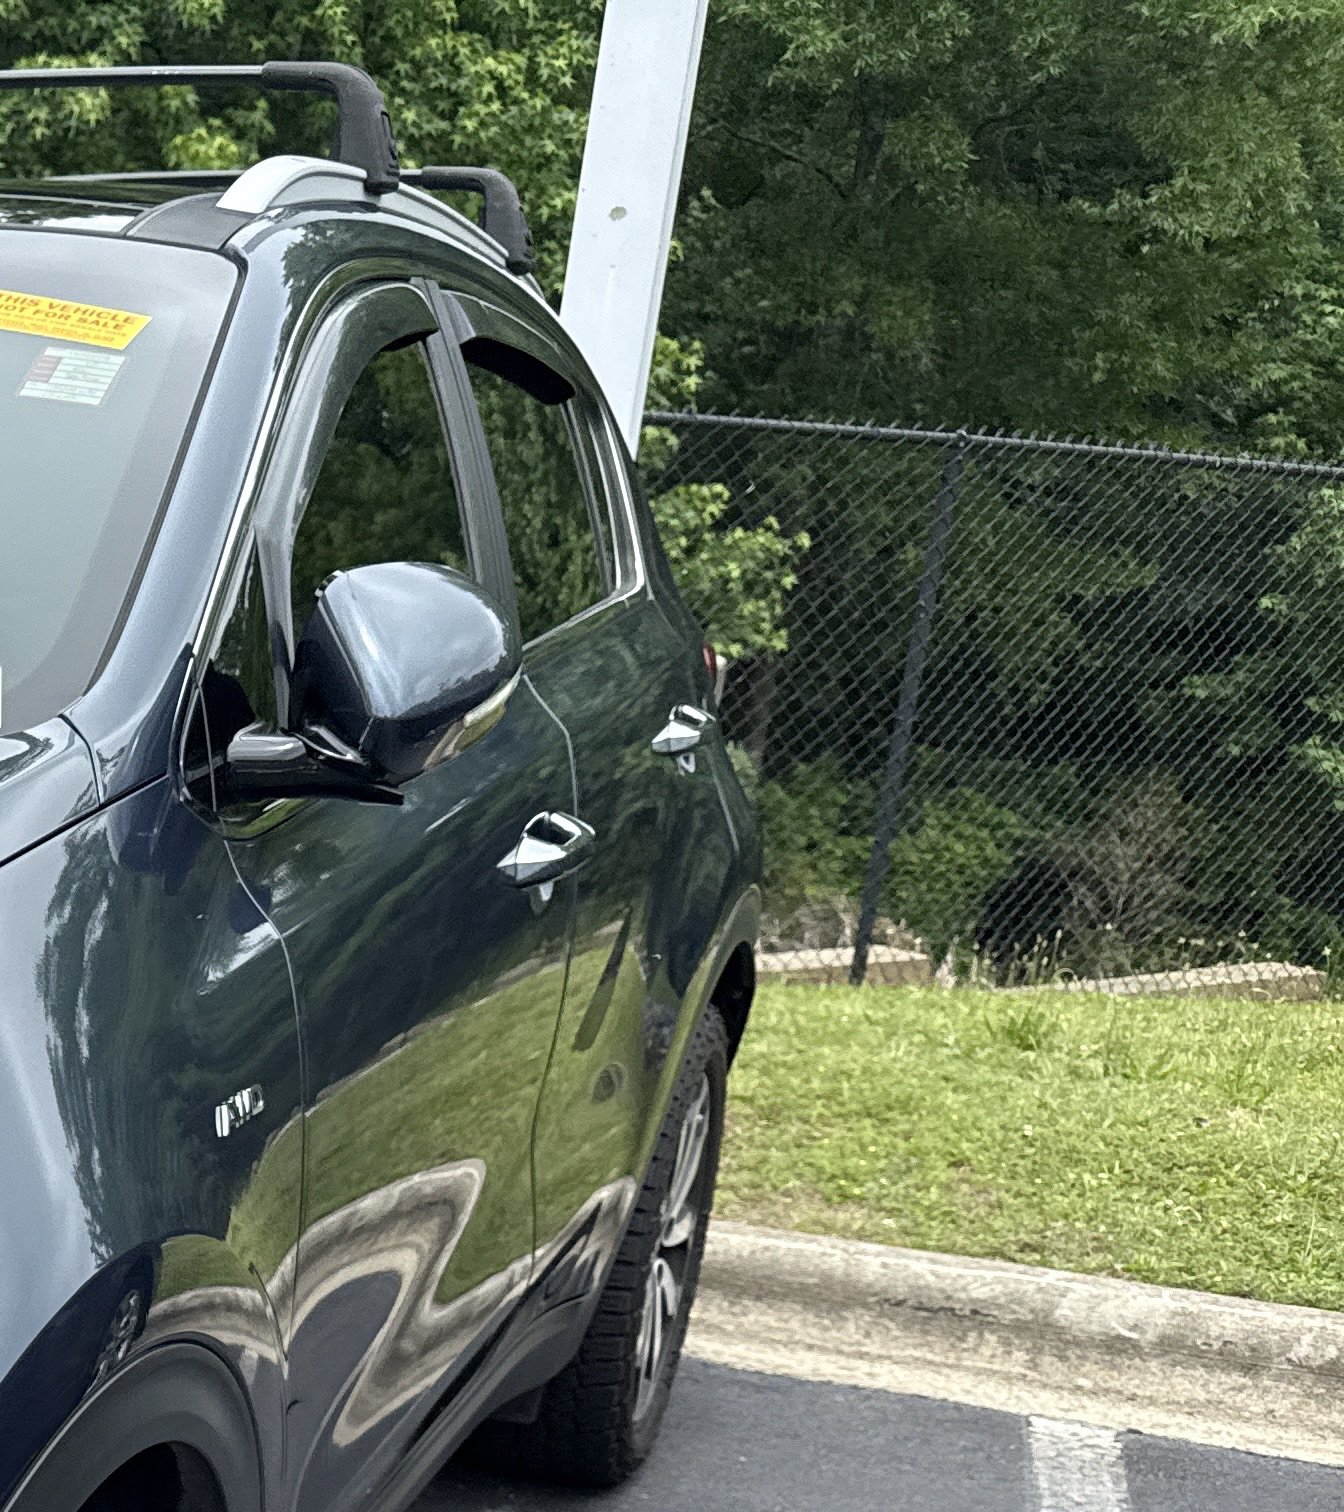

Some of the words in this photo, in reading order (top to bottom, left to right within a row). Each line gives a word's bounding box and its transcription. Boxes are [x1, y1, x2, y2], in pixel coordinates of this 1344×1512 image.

[33, 308, 72, 321] FOR
[79, 317, 128, 331] SALE
[47, 301, 140, 325] VEHICLE
